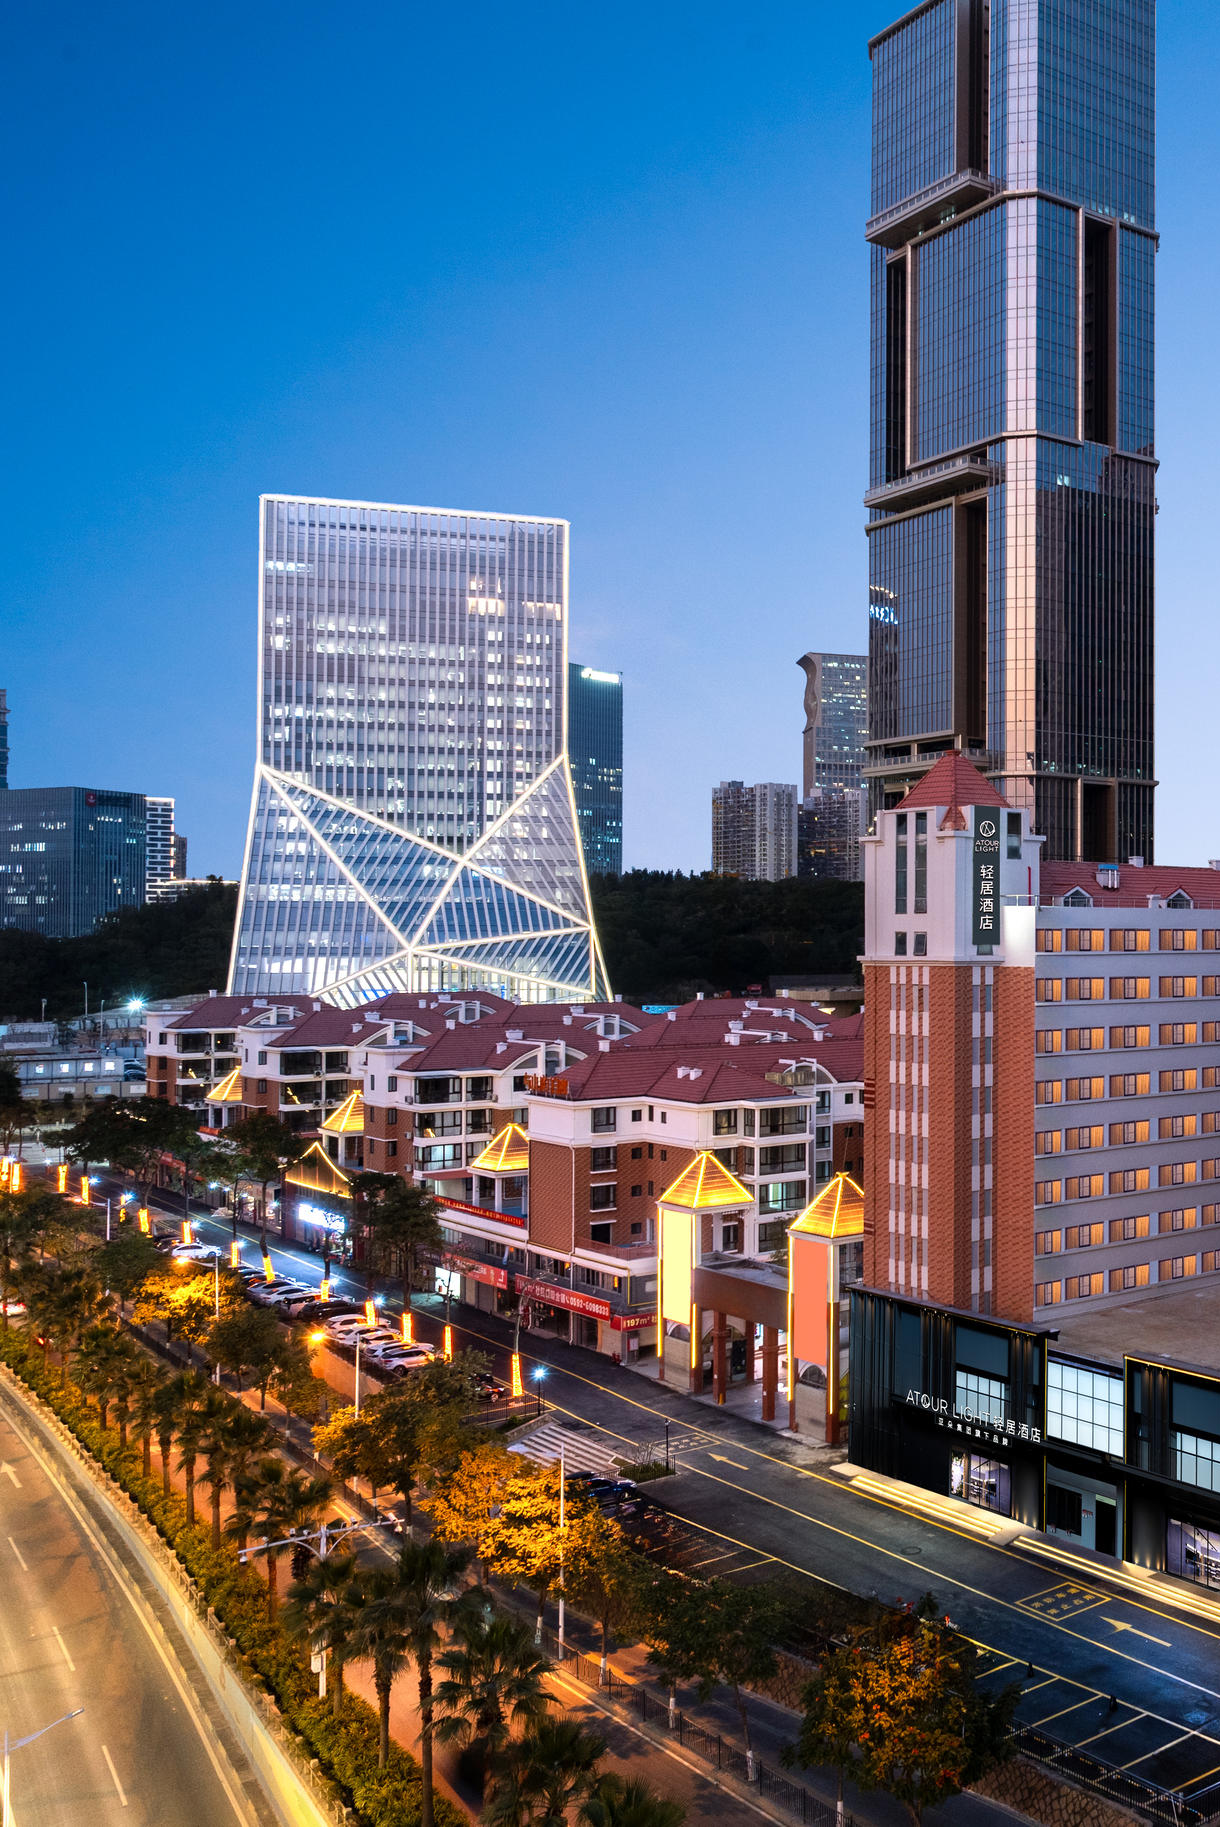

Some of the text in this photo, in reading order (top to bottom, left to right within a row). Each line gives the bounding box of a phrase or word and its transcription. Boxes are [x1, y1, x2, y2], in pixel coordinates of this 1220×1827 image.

[975, 839, 1000, 847] ATOUR
[979, 864, 994, 930] 轻居酒店
[905, 1389, 1042, 1444] ATOUR LIGHT 轻居酒店
[938, 1417, 1009, 1446] 亚朵集团旗下品牌
